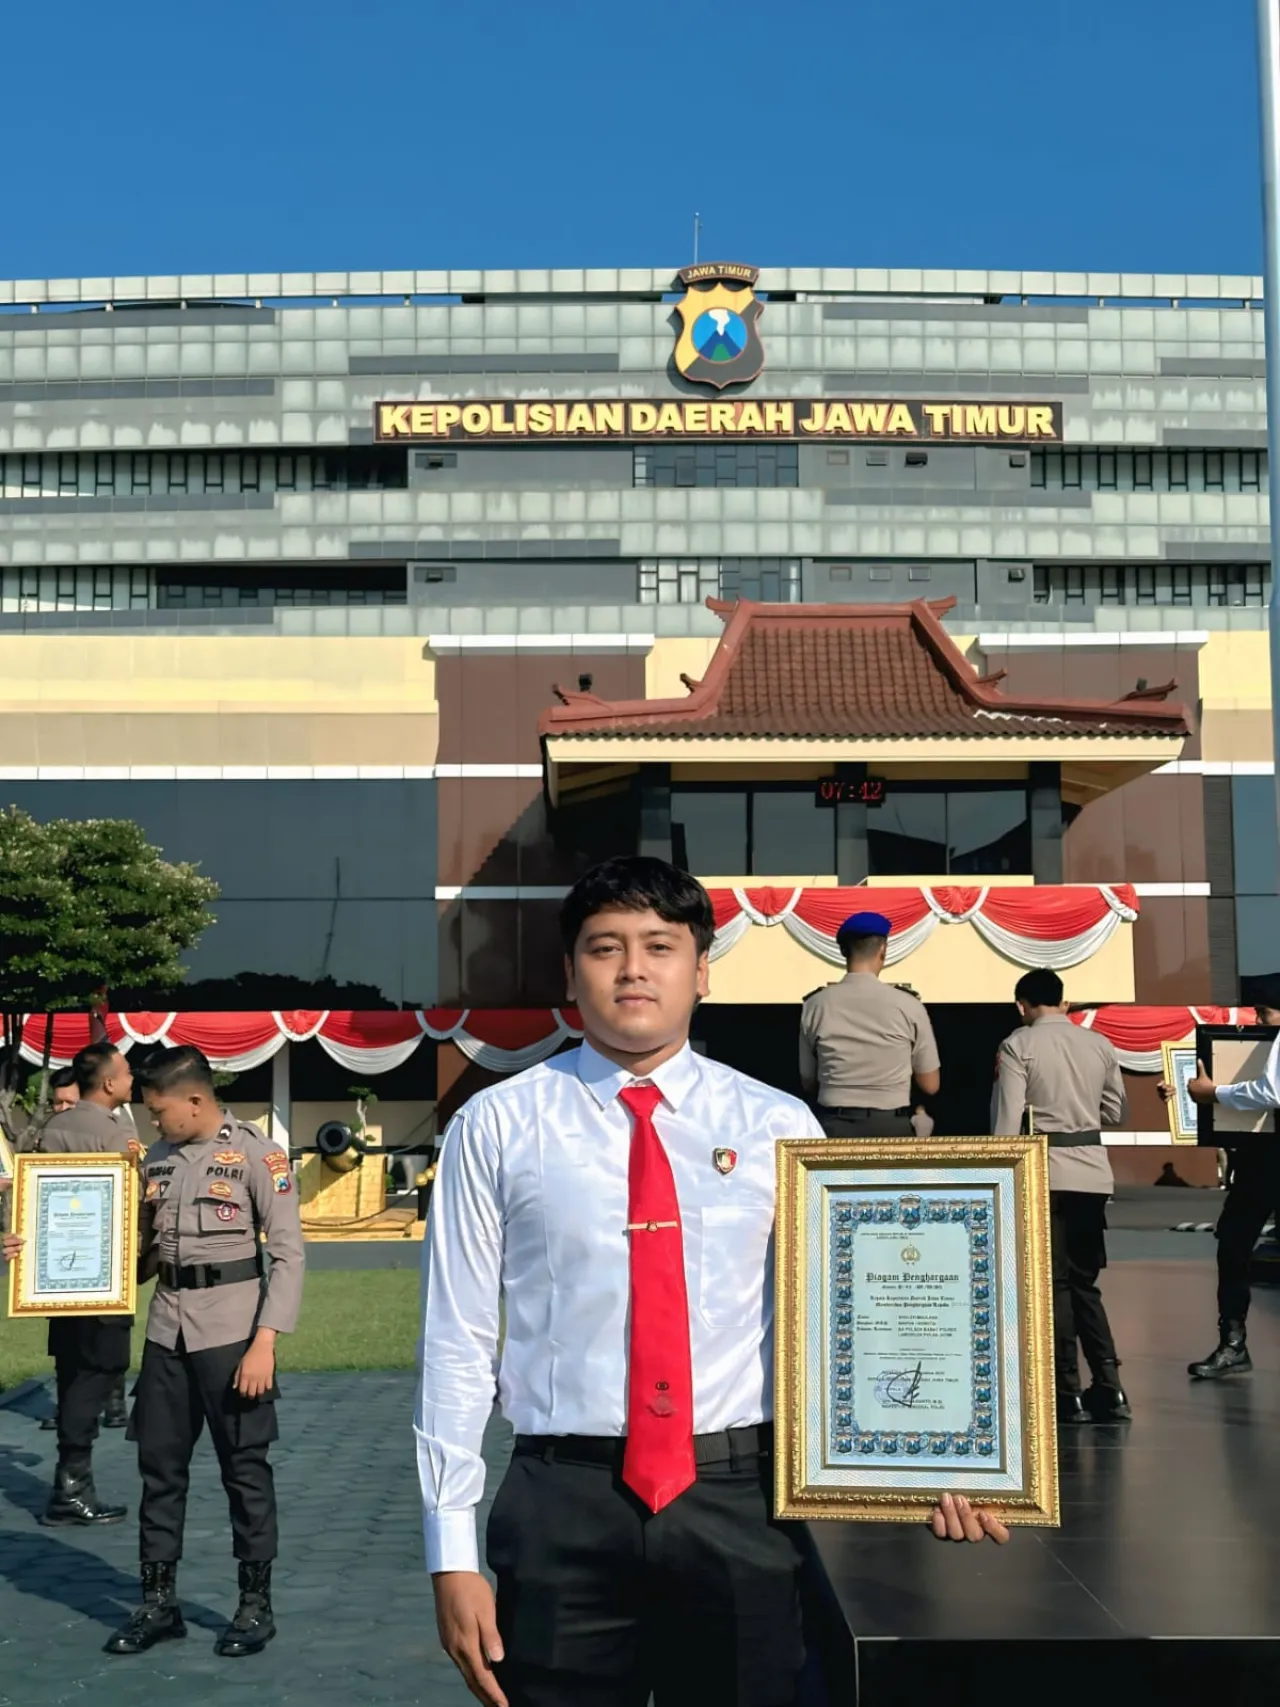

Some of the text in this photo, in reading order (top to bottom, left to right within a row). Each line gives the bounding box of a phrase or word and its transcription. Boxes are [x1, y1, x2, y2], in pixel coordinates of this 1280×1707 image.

[688, 265, 752, 279] JAWA TIMUR
[379, 401, 1056, 438] KEPOLISIAN DAERAH JAWA TIMUR
[820, 780, 882, 800] 07:42
[206, 1165, 244, 1181] POLRI
[866, 1272, 960, 1283] Piagam Penghargaan
